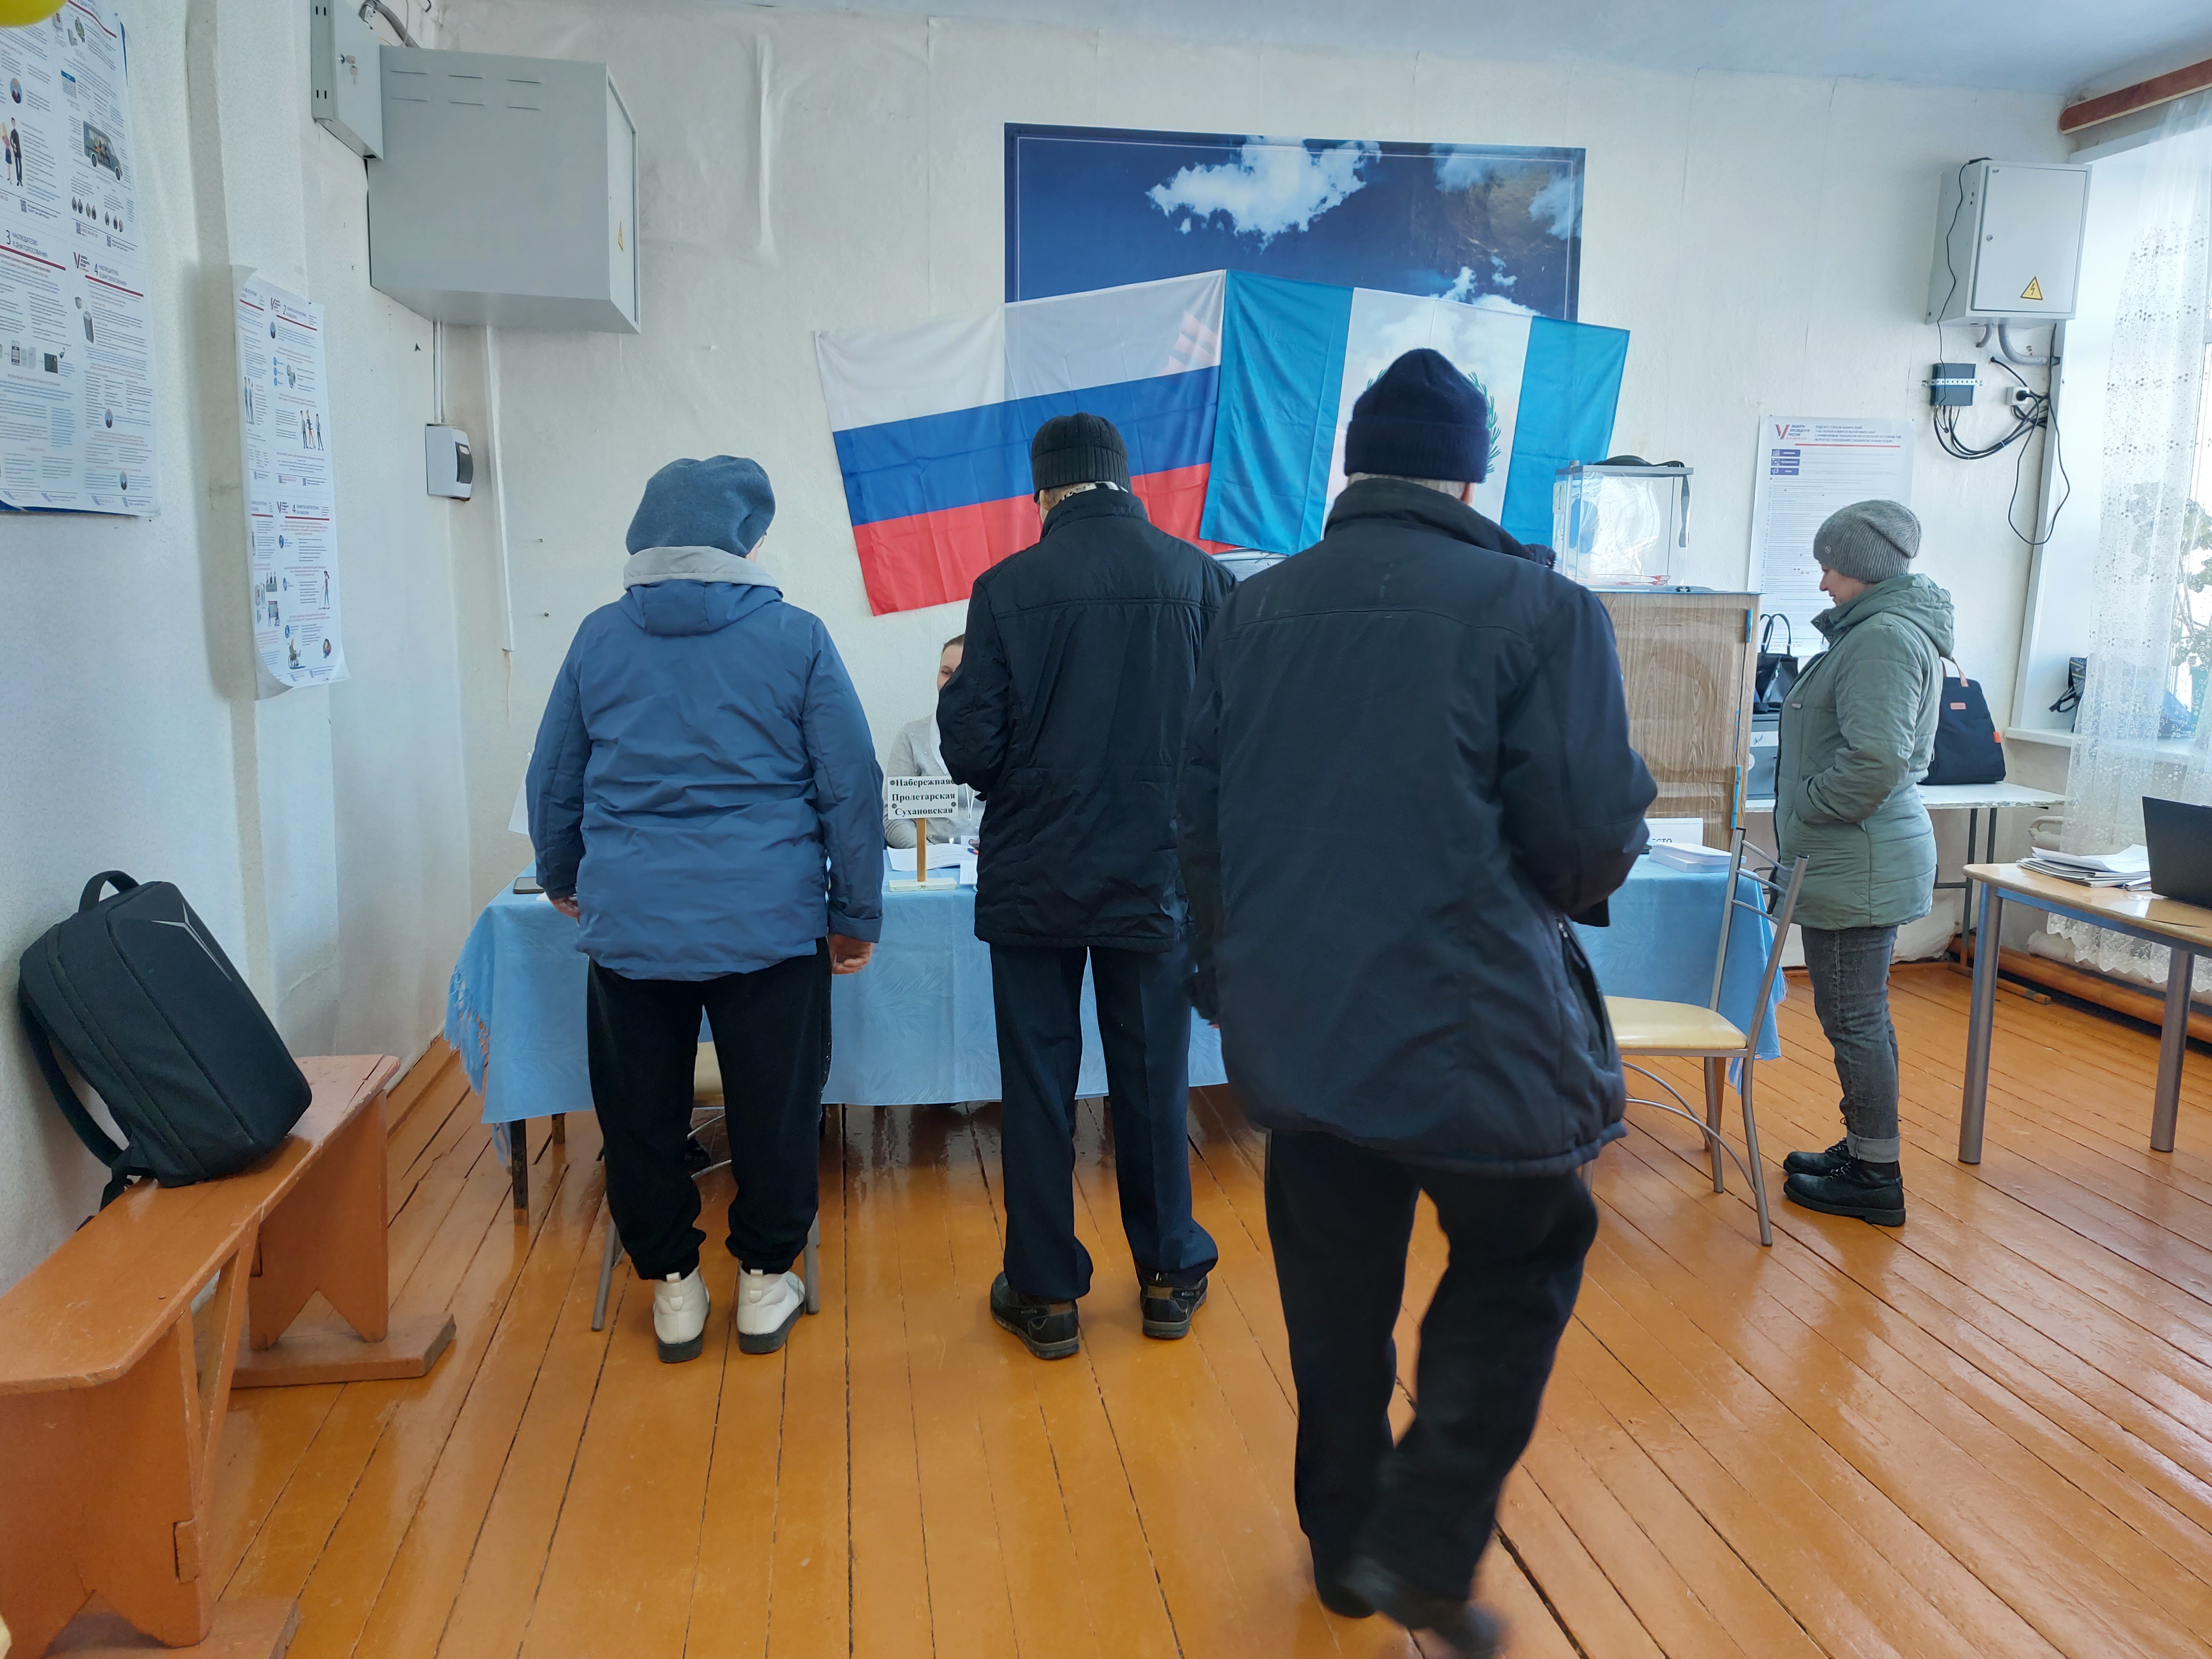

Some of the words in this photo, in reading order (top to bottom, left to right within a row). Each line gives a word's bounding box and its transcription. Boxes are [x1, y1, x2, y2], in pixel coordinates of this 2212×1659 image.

[6, 230, 11, 245] 3
[94, 263, 99, 276] 4
[283, 304, 286, 315] 2
[1556, 486, 1561, 509] 1
[292, 504, 296, 514] 4
[896, 779, 951, 787] Набережная
[892, 793, 955, 803] Пролетарская
[895, 807, 953, 817] Сухановская
